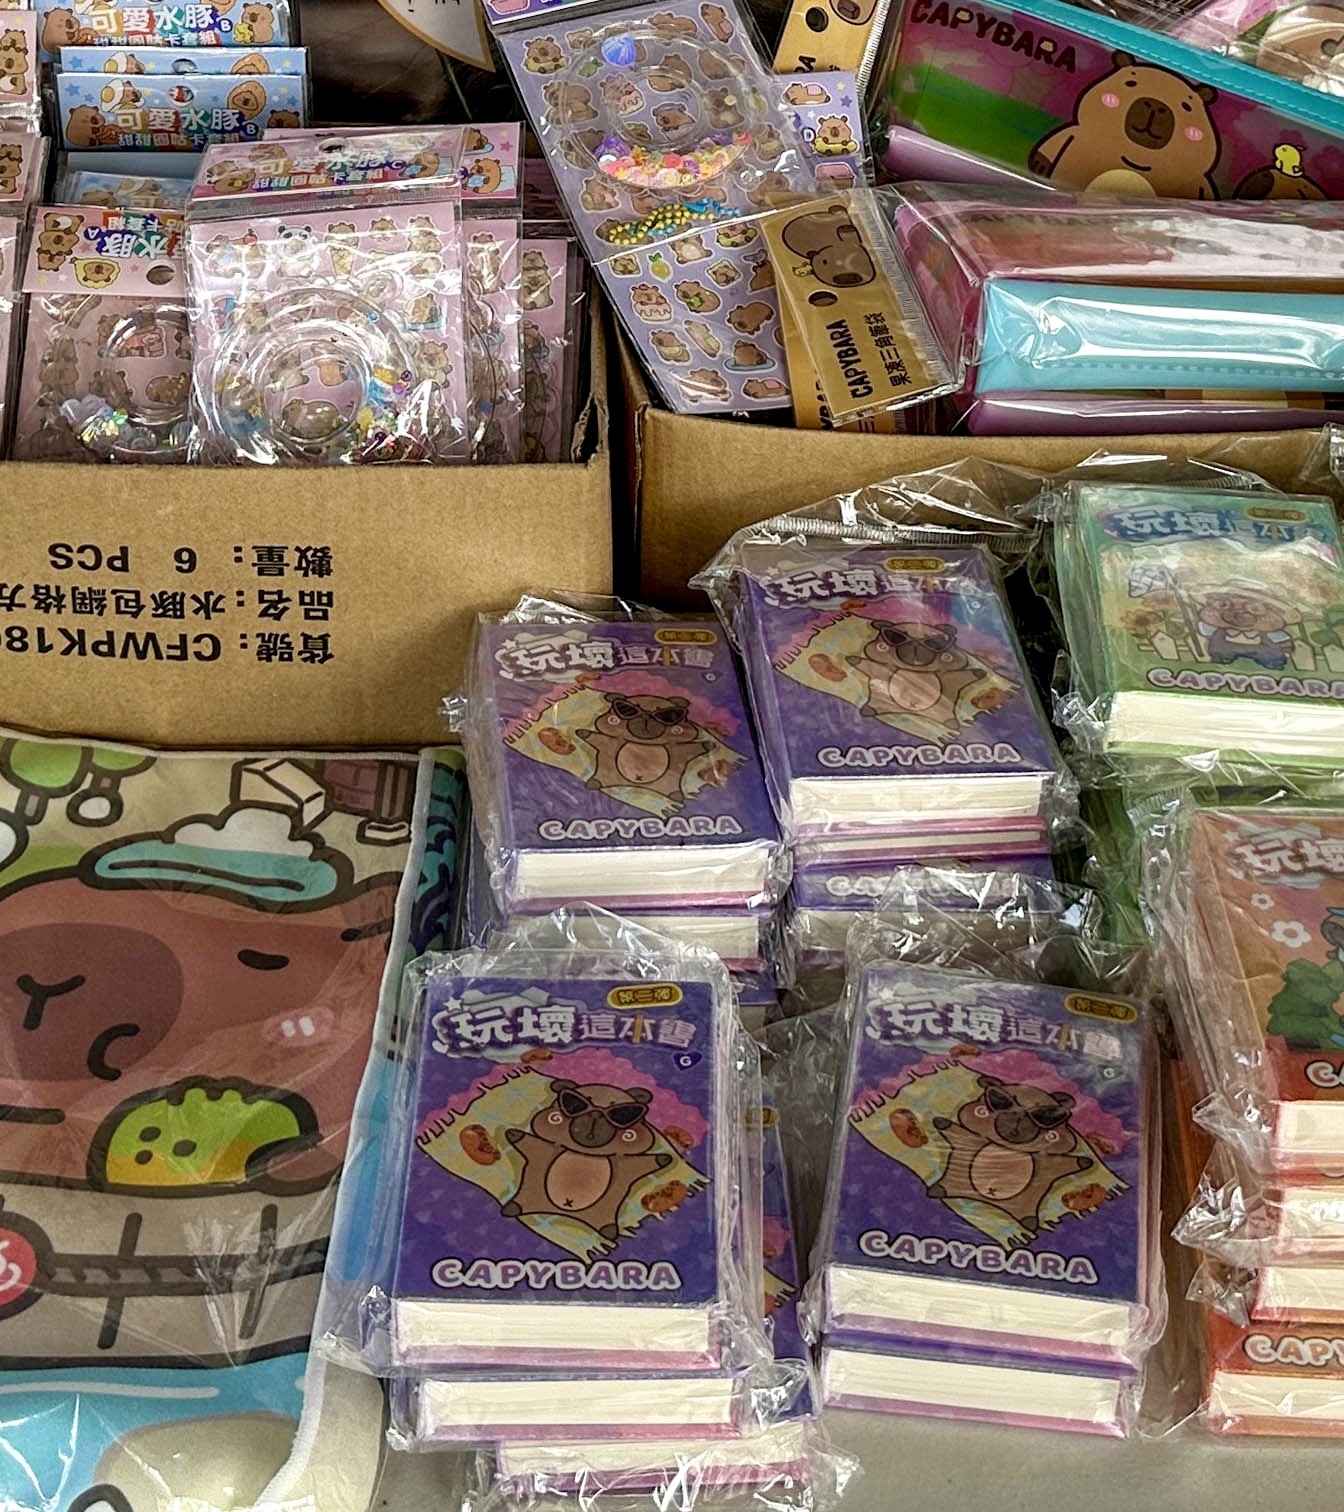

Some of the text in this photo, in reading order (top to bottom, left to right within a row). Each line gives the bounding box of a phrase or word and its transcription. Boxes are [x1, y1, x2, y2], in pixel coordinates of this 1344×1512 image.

[91, 4, 213, 32] 可愛水豚
[115, 108, 240, 131] 可愛水豚
[836, 319, 873, 399] CAPYBARA
[48, 542, 333, 578] 數量: 6 PCS
[818, 743, 1020, 768] CAPYBARA
[538, 815, 742, 841] CAPYBARA
[450, 1005, 696, 1049] 玩壞這本書
[431, 1257, 680, 1289] CAPYBARA
[859, 1231, 1098, 1284] CAPYBARA
